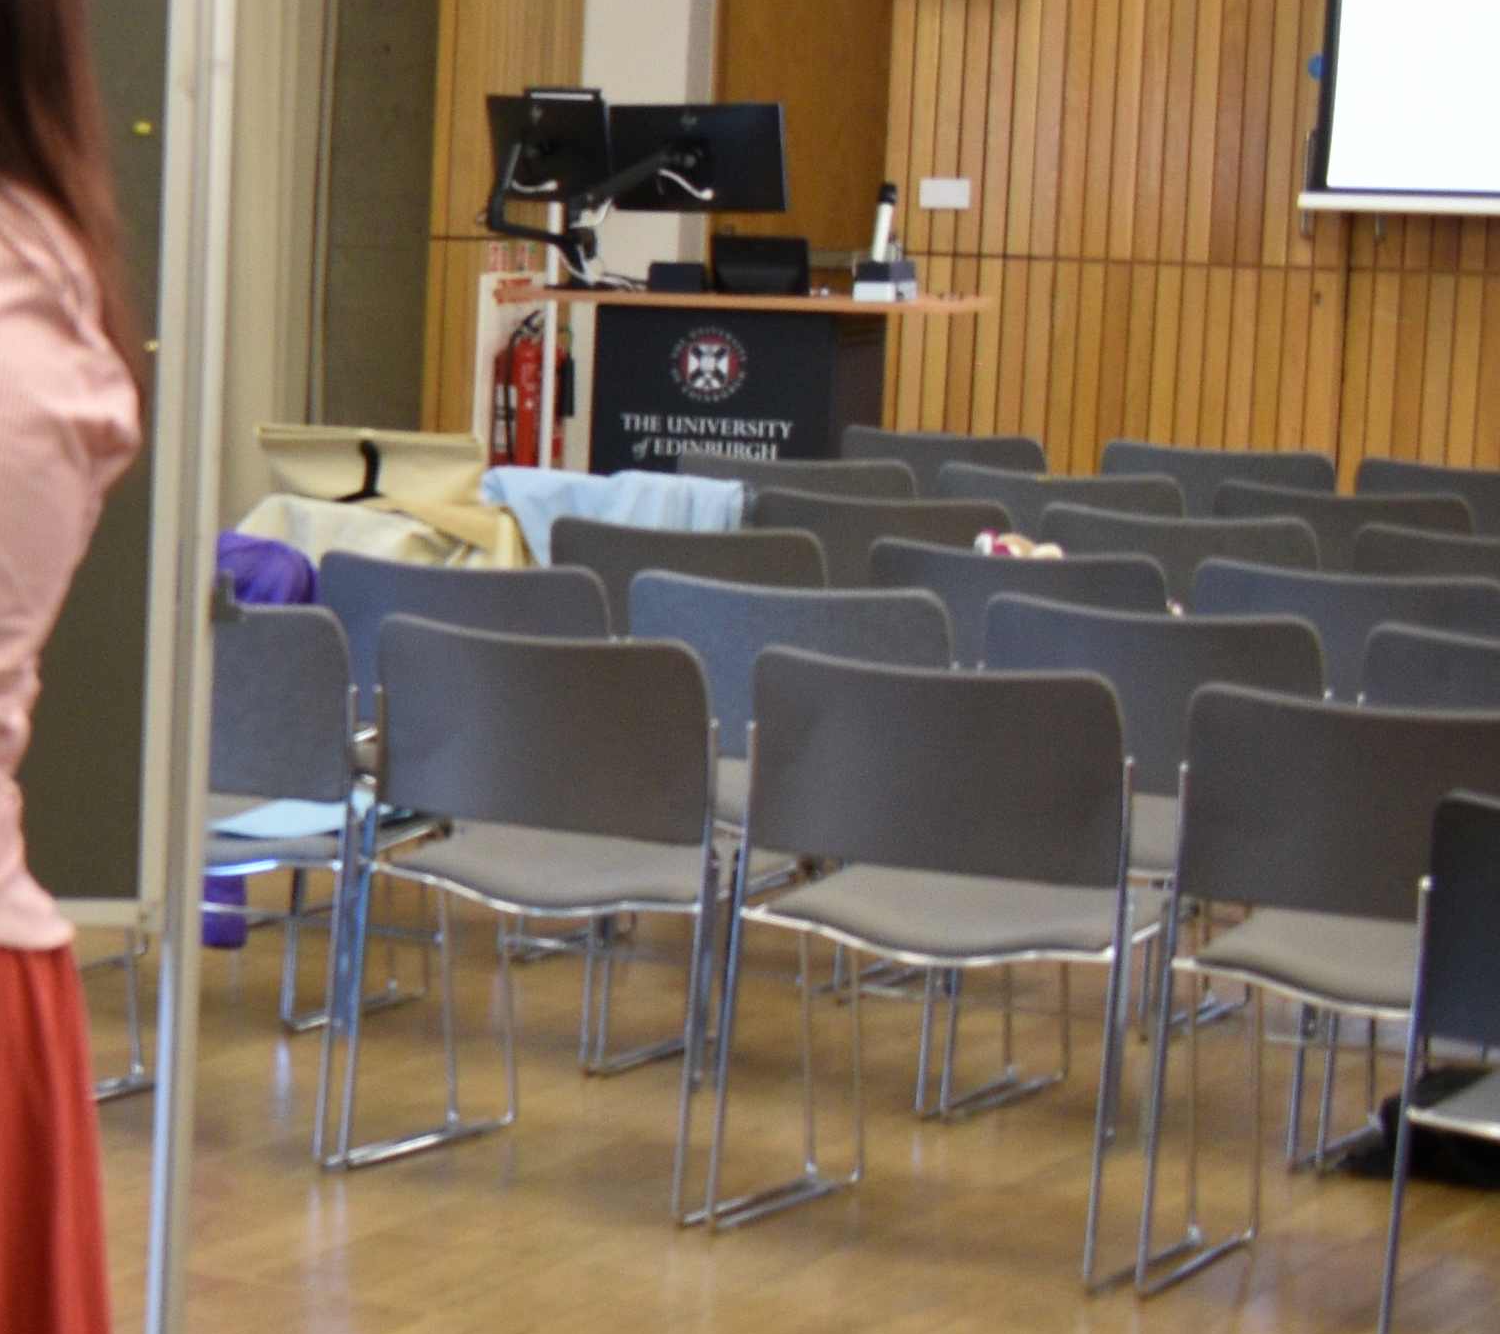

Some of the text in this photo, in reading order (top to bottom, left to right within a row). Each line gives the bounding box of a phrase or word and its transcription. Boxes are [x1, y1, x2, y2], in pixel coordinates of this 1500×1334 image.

[621, 413, 794, 439] THE UNIVERSITY
[632, 438, 780, 461] of EDINBURGH
